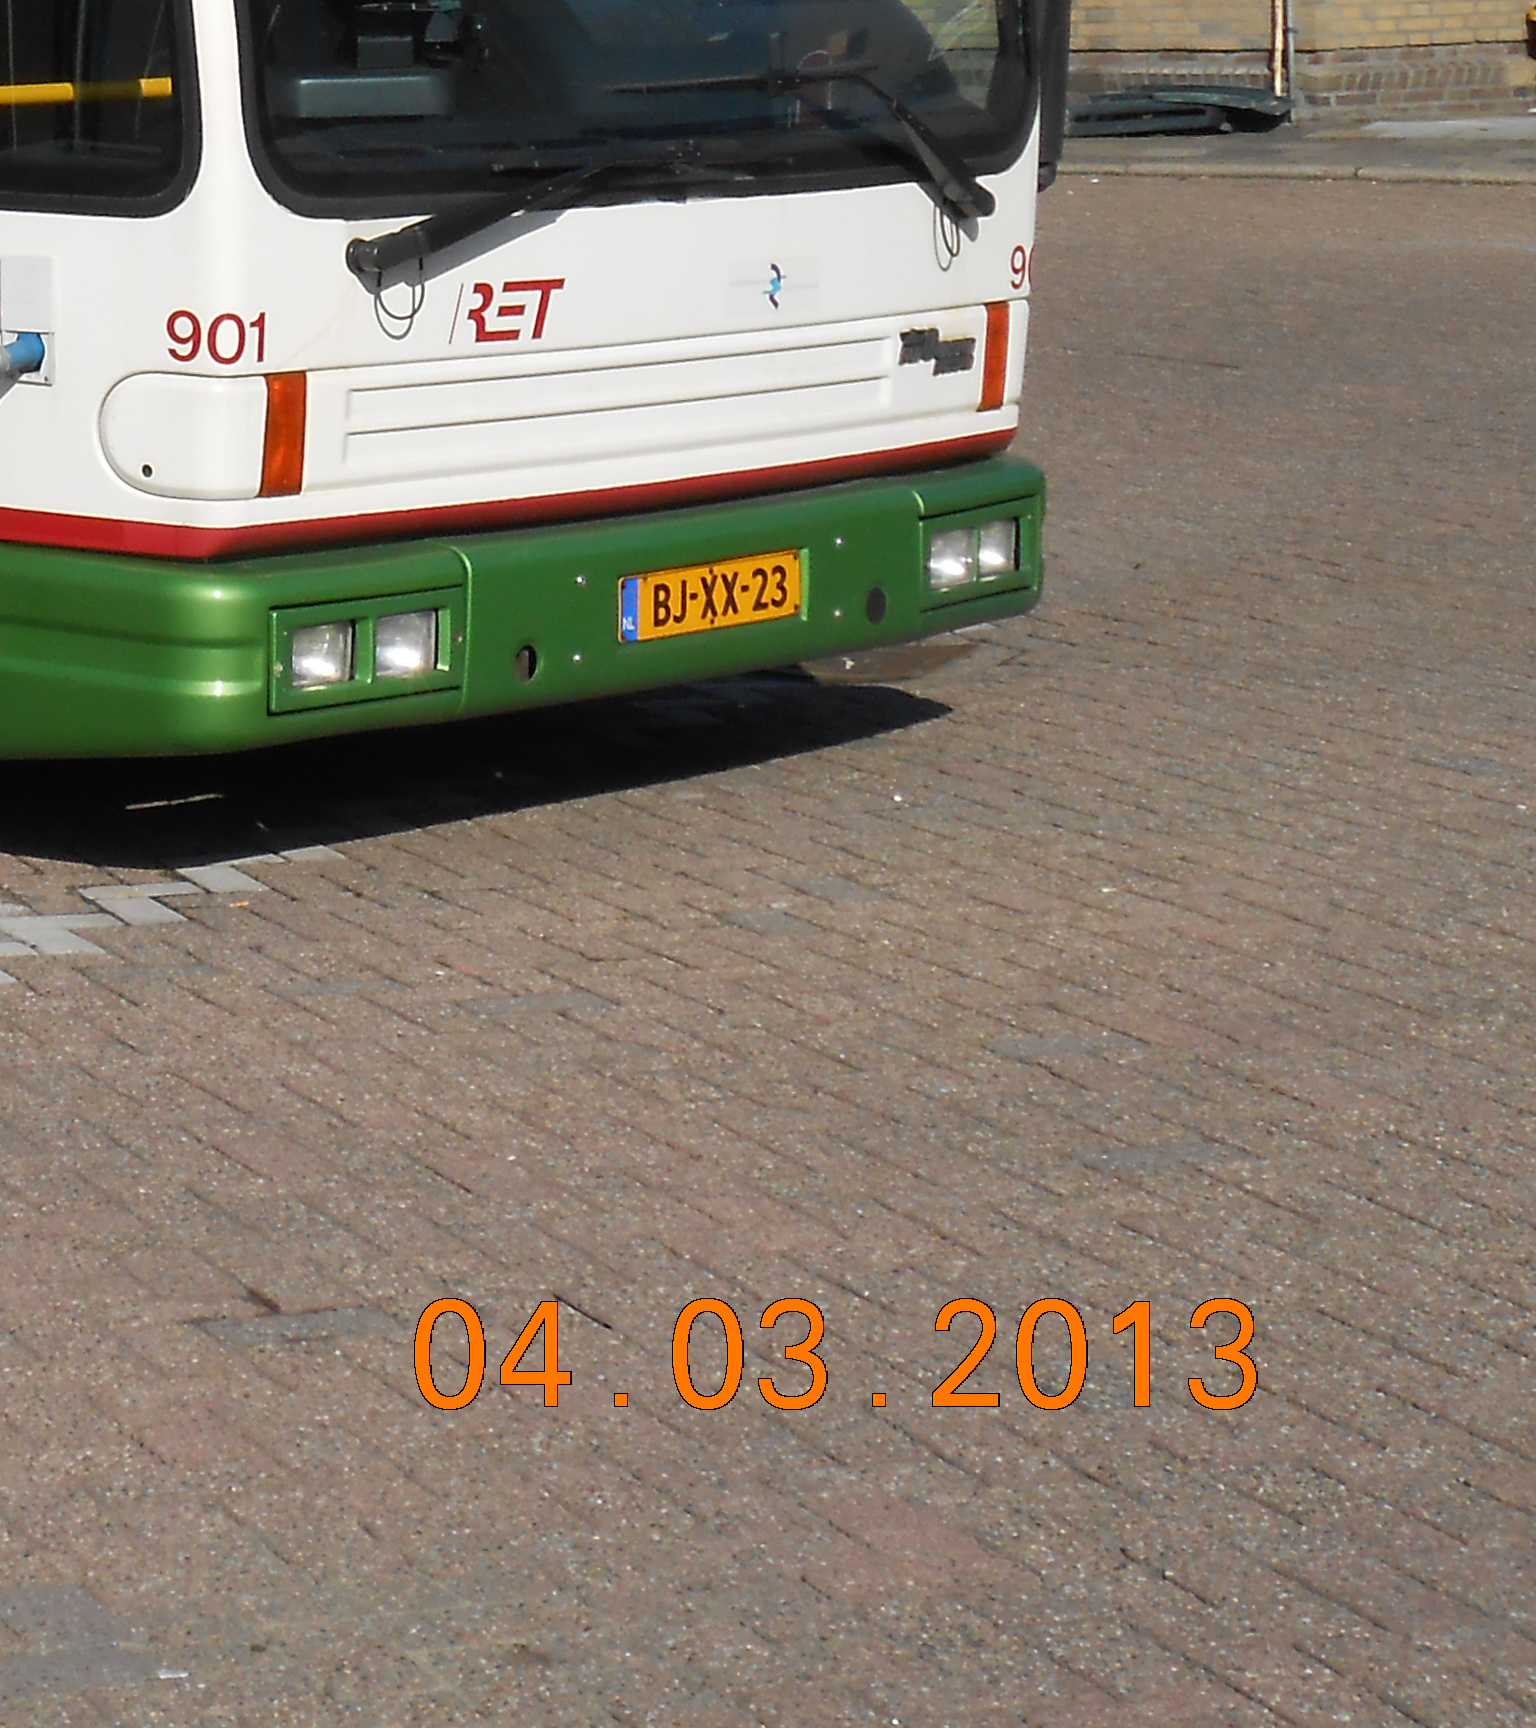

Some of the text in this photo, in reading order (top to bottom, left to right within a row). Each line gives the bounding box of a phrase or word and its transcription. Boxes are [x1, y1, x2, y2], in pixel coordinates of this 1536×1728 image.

[1010, 243, 1036, 292] 9
[165, 308, 267, 366] 901
[466, 277, 567, 344] RET
[652, 564, 789, 628] BJ-XX-23
